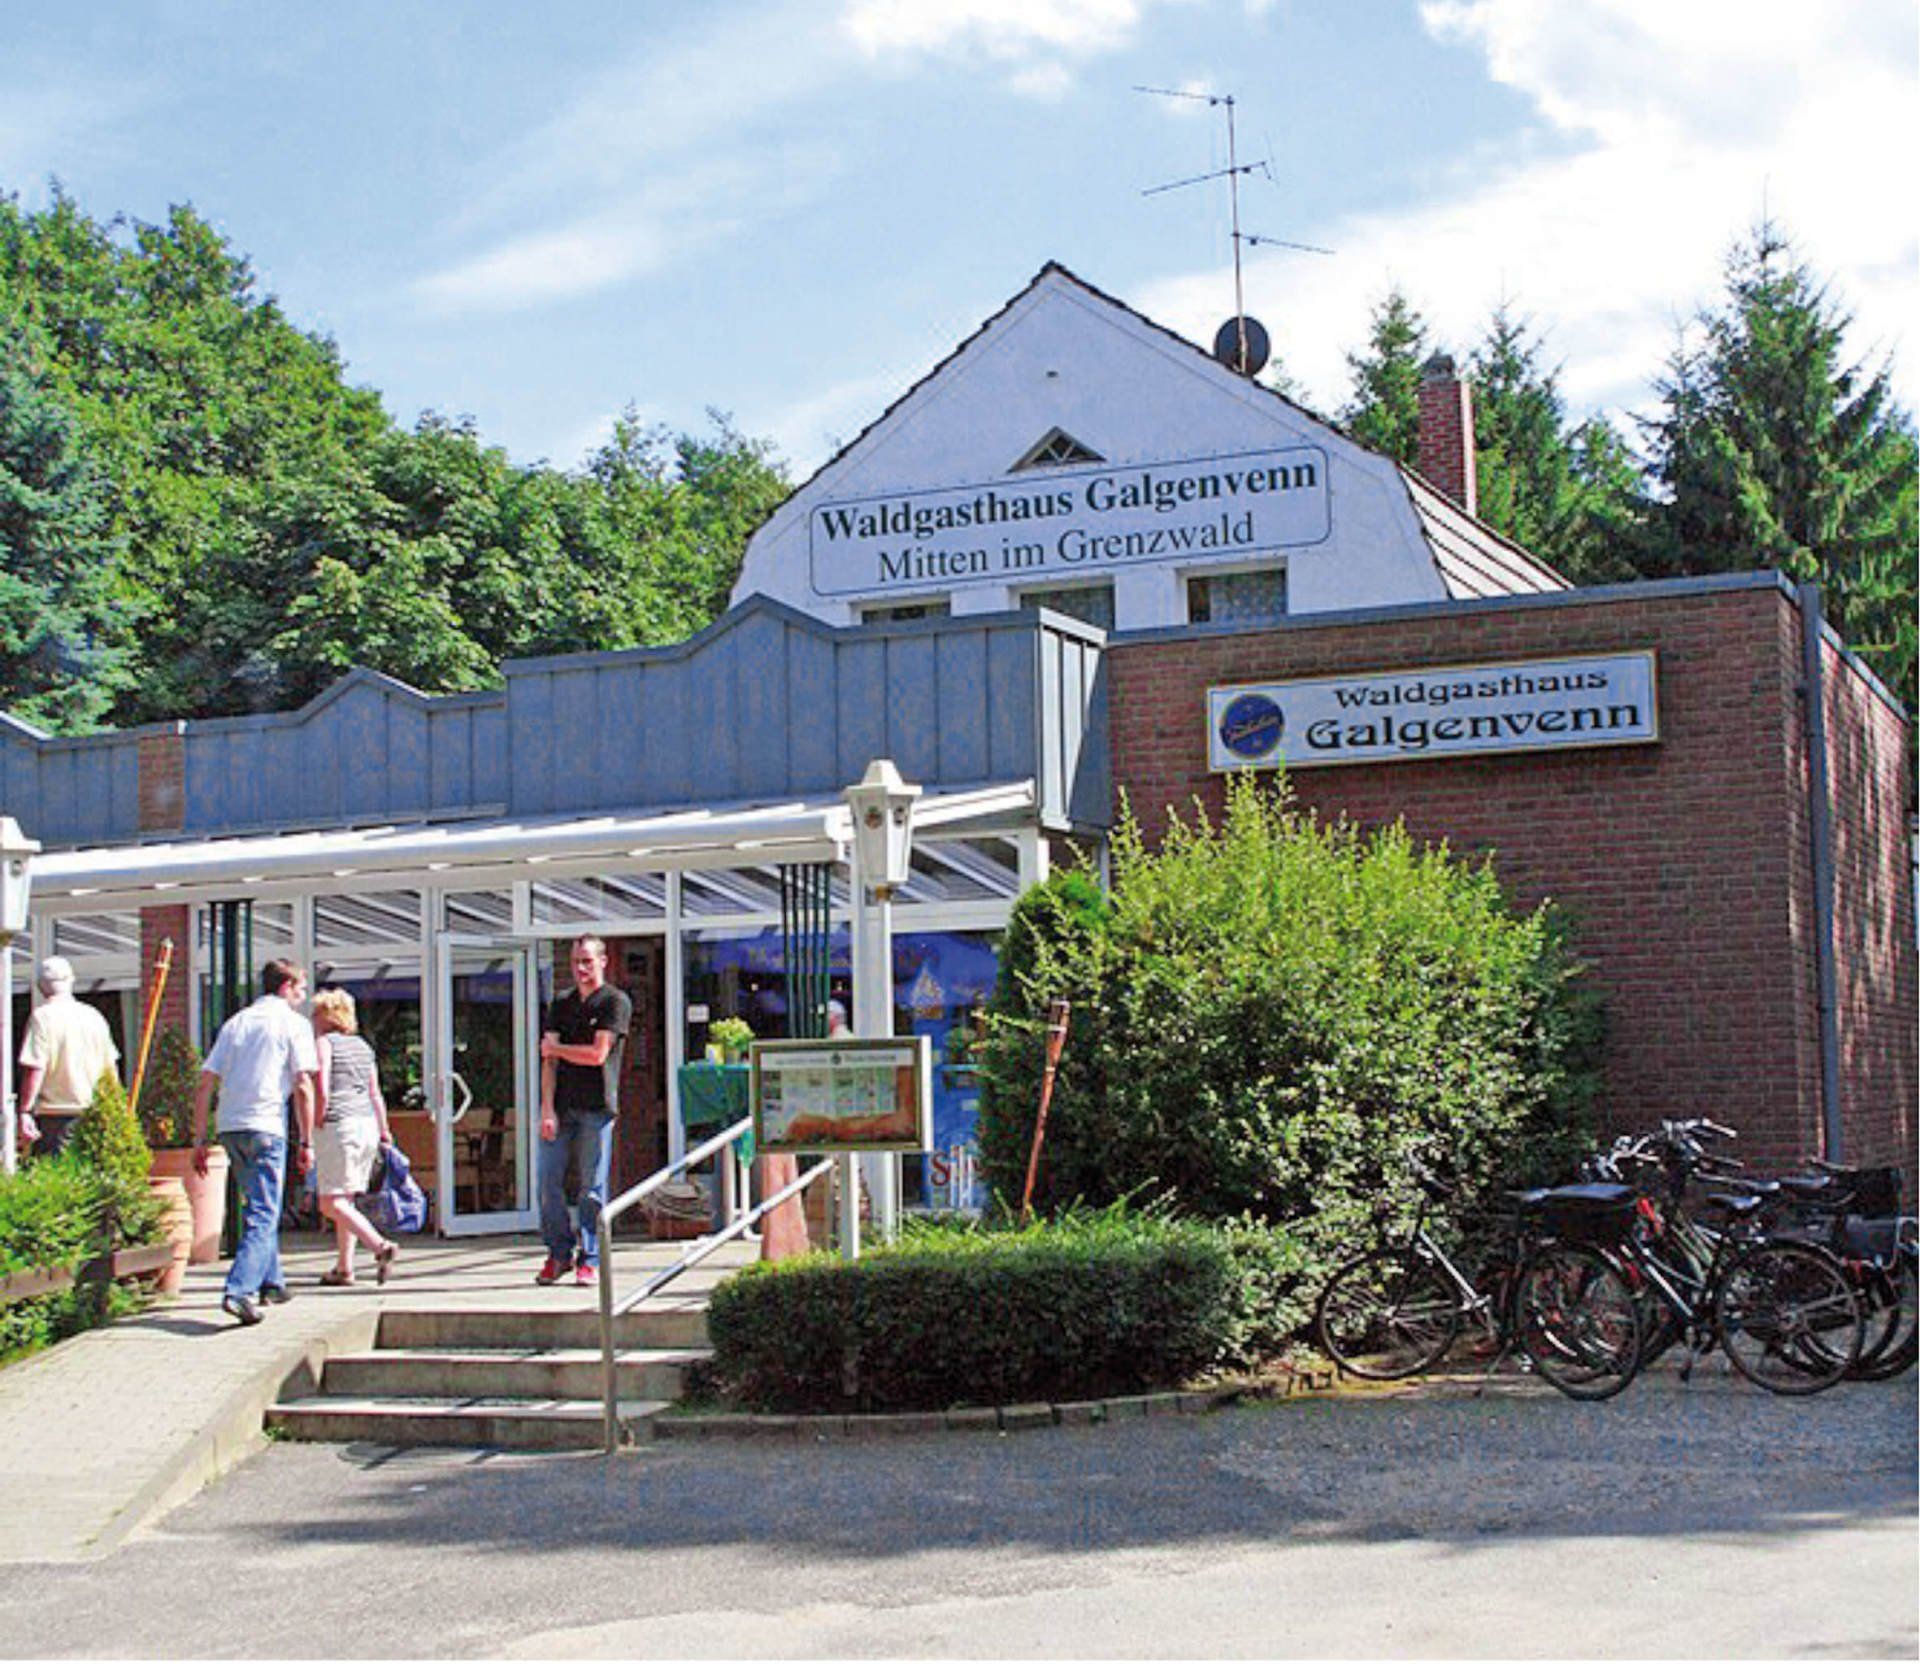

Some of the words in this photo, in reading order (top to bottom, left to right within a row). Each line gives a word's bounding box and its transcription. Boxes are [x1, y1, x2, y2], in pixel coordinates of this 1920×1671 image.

[821, 491, 1073, 540] Waldgasthaus
[1086, 462, 1317, 513] Galgenvenn
[879, 547, 987, 582] Mitten
[1002, 538, 1045, 568] im
[1057, 510, 1255, 562] Grenzwald
[1335, 669, 1608, 709] Waldgasthaus
[1306, 703, 1643, 750] Galgenvenn
